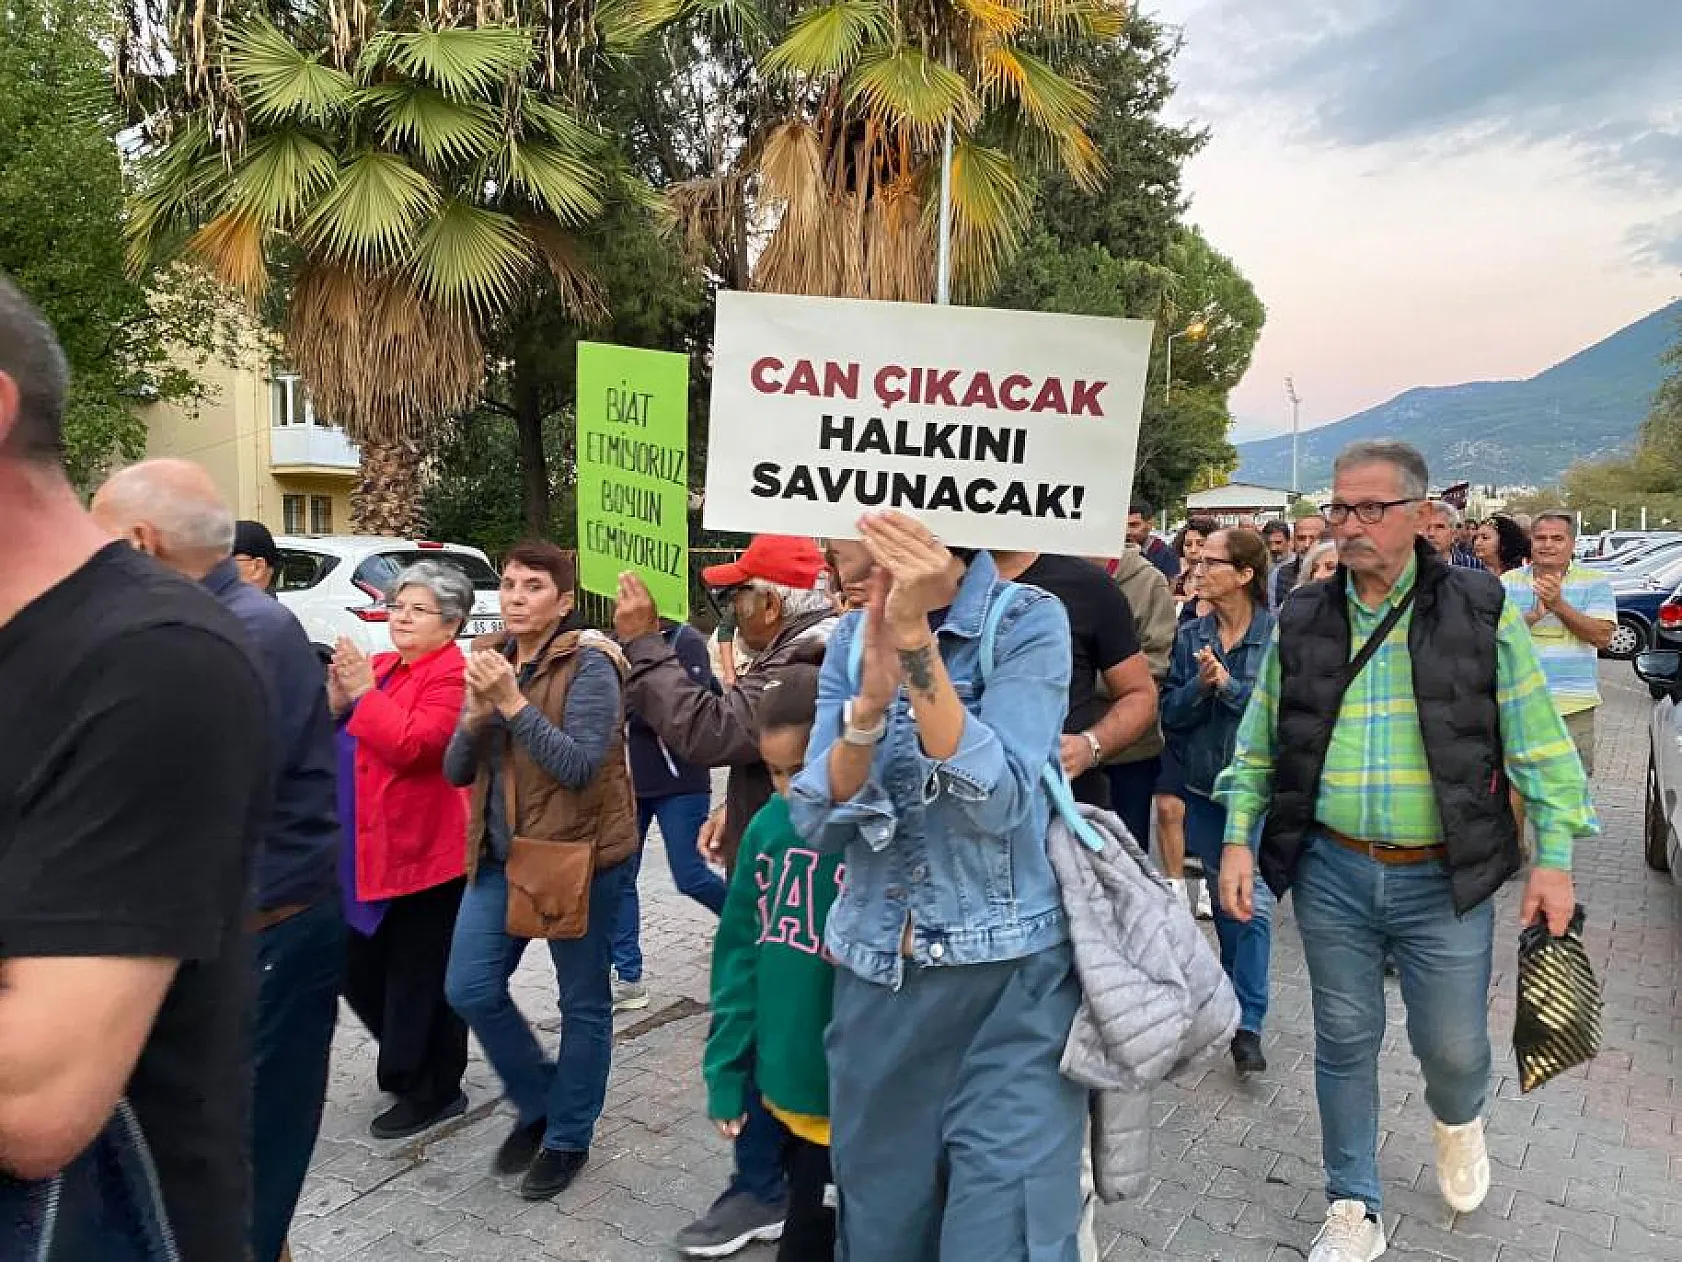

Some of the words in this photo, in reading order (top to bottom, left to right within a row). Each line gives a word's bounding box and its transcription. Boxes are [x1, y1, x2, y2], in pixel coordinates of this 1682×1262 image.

[606, 380, 654, 427] BİAT
[751, 357, 860, 399] CAN
[873, 366, 1108, 416] ÇIKACAK
[586, 431, 685, 486] ETMİYORUZ
[819, 415, 1028, 464] HALKINI
[602, 480, 662, 526] BOYUN
[751, 462, 1085, 519] SAVUNACAK!
